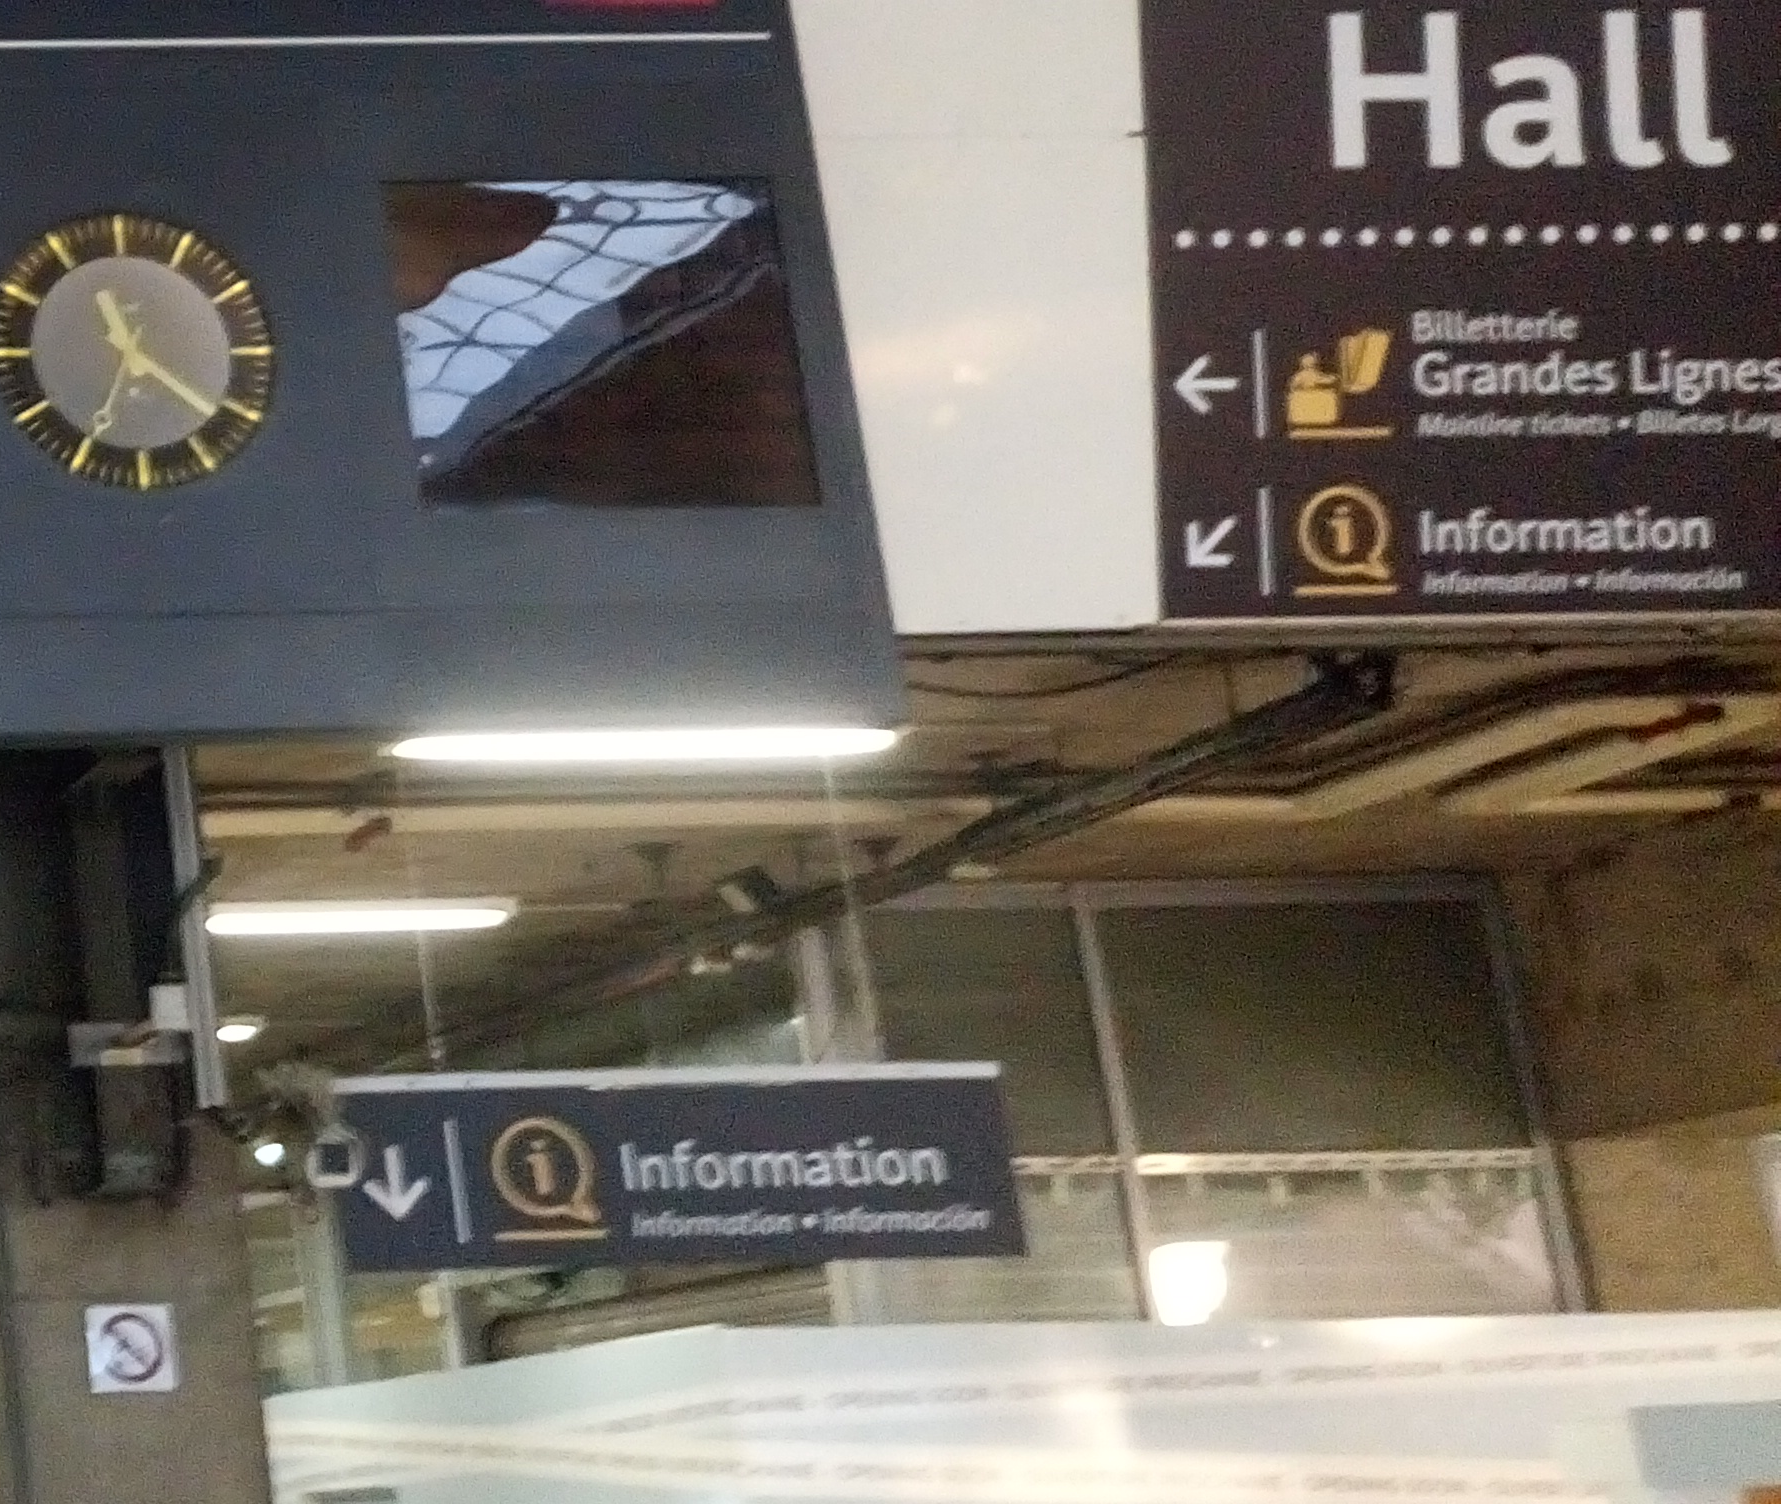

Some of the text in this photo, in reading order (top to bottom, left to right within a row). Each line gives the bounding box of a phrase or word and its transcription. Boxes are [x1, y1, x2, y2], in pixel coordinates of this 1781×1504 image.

[1327, 9, 1734, 170] Hall
[1410, 308, 1580, 345] Billetterie
[1411, 347, 1781, 405] Grandes Lignes
[1418, 505, 1716, 554] Information
[619, 1135, 950, 1191] Information
